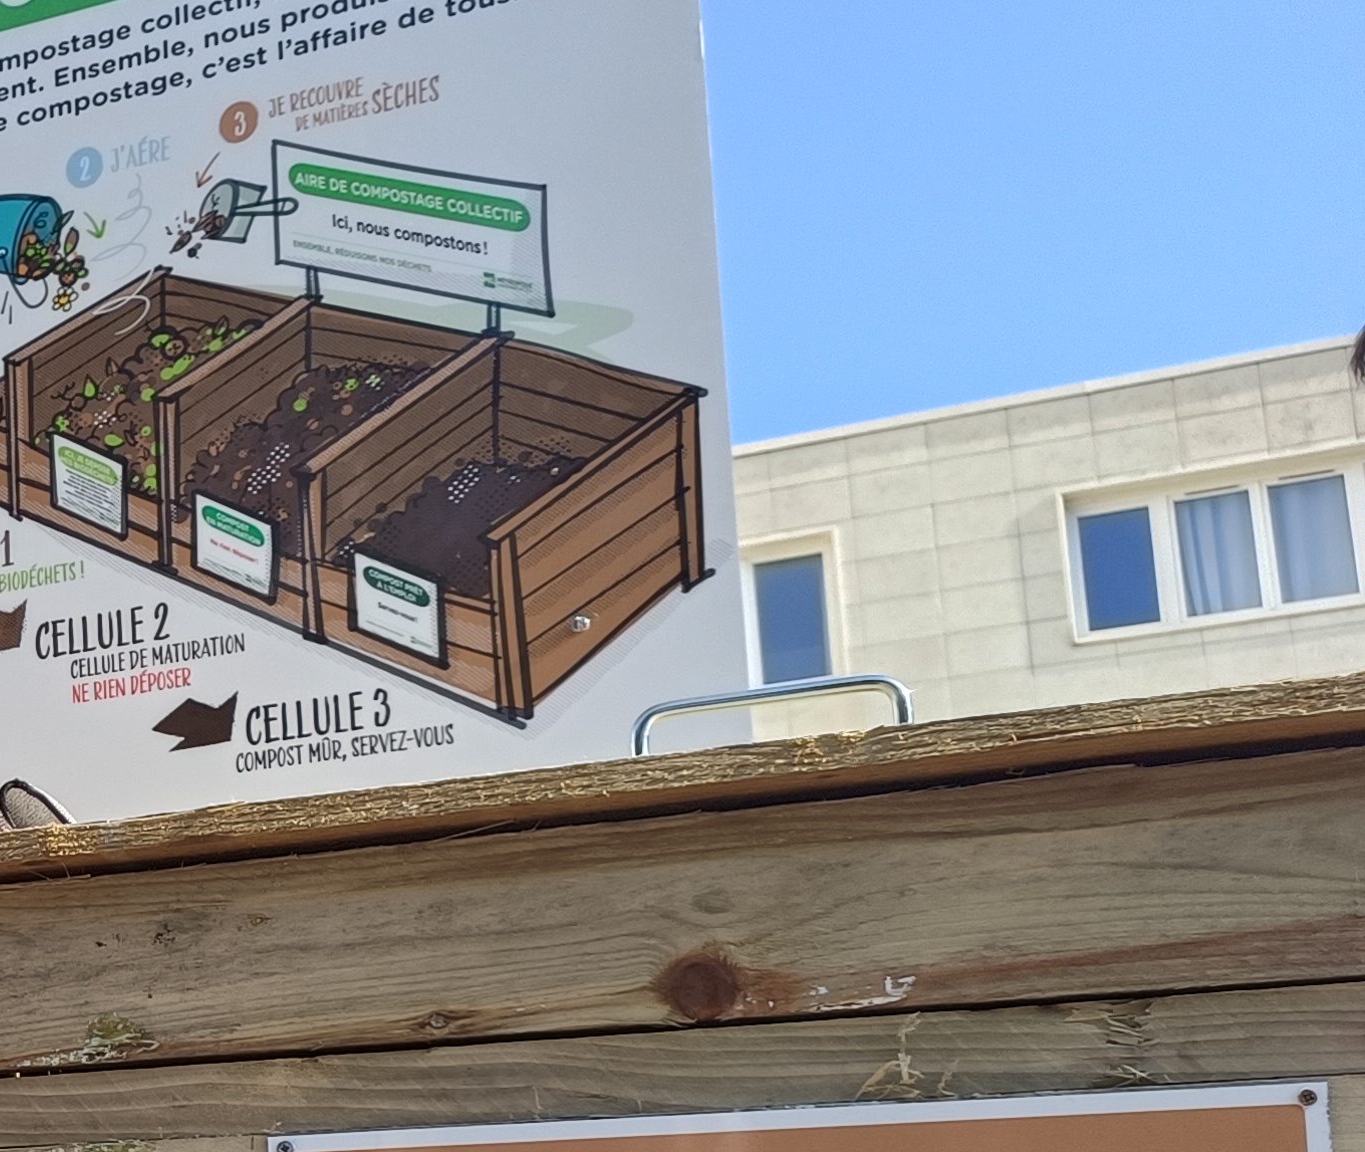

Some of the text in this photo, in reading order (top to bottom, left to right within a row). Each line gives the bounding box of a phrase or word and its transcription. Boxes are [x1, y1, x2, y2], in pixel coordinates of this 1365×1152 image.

[234, 77, 362, 136] 3 JE RECOUVRE
[296, 74, 439, 132] DE MATIÈRES SÈCHES
[294, 172, 524, 223] AIRE DE COMPOSTAGE COLLECTIF
[332, 213, 352, 233] Ici,
[356, 221, 389, 237] nous
[0, 529, 14, 567] 1
[35, 602, 170, 660] CELLULE 2
[70, 633, 245, 679] CELLULE DE MATURATION
[72, 667, 191, 703] NE RIEN DÉPOSER
[245, 687, 390, 745] CELLULE 3
[235, 723, 454, 773] COMPOST MÛR, SERVEZ-VOUS
